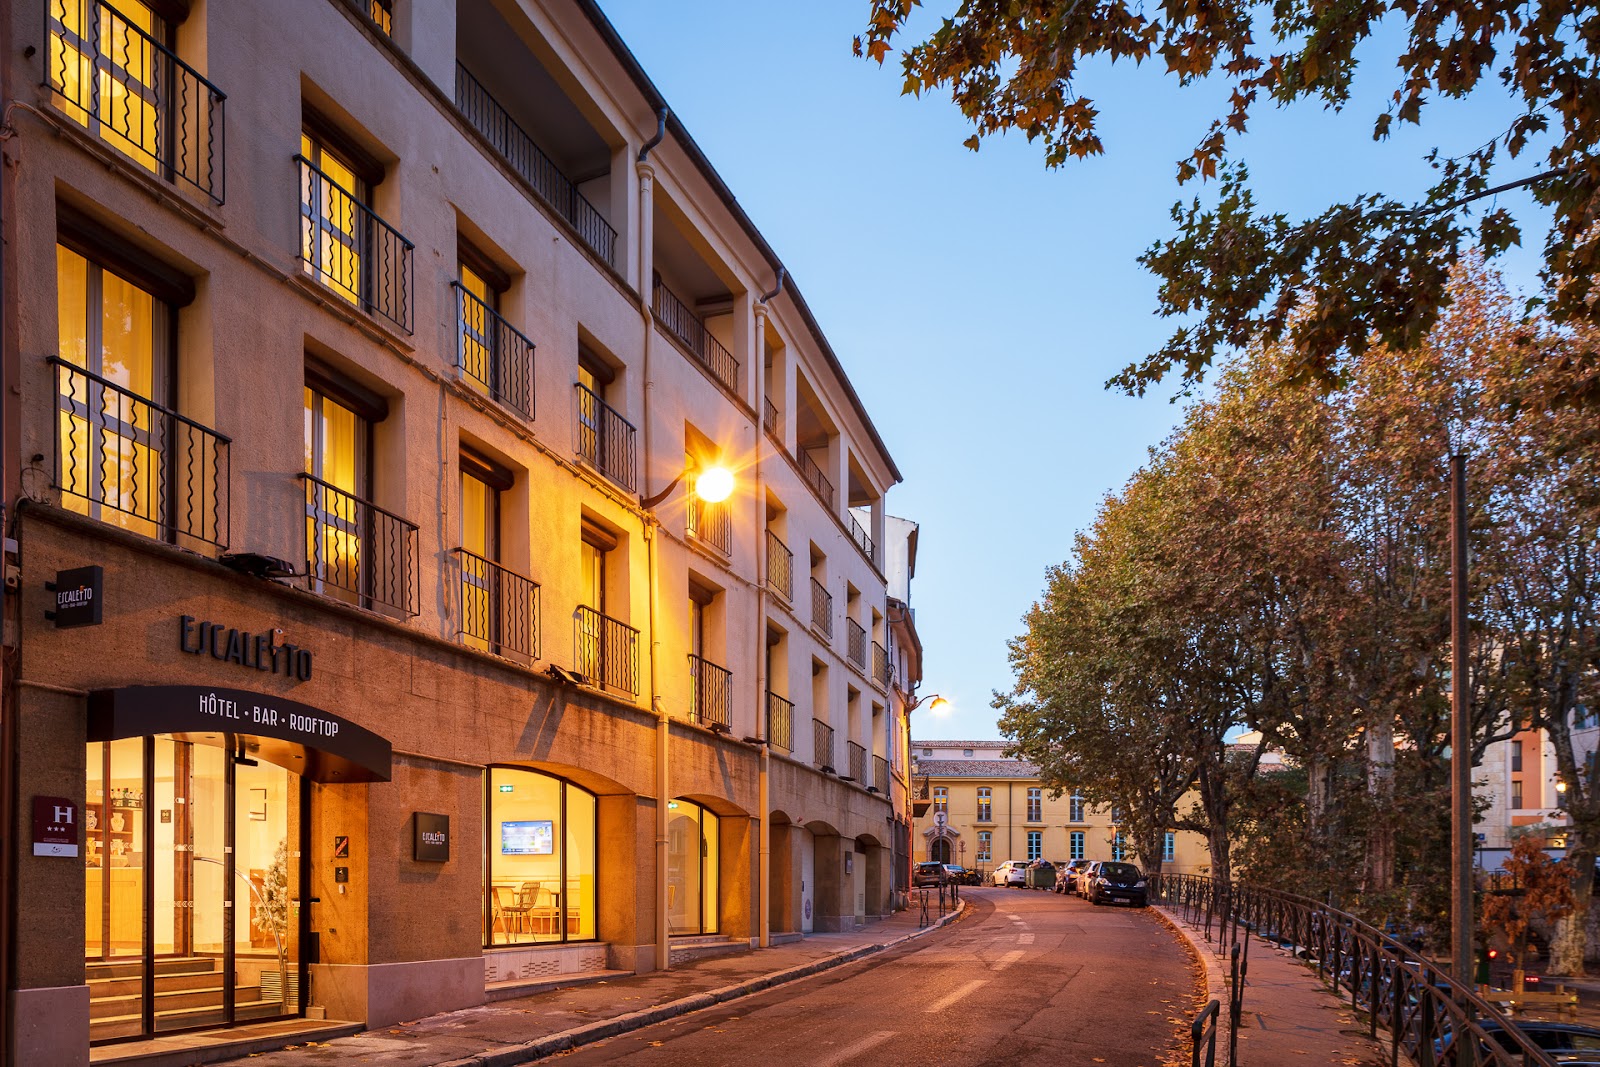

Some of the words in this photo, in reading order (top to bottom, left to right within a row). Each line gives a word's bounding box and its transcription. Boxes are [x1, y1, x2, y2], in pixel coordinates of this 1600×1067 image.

[57, 587, 93, 604] ESCALETTO
[181, 615, 312, 681] ESCALETTO
[199, 693, 240, 719] HÔTEL
[253, 706, 278, 726] BAR
[289, 713, 339, 737] ROOFTOP
[53, 805, 74, 824] H
